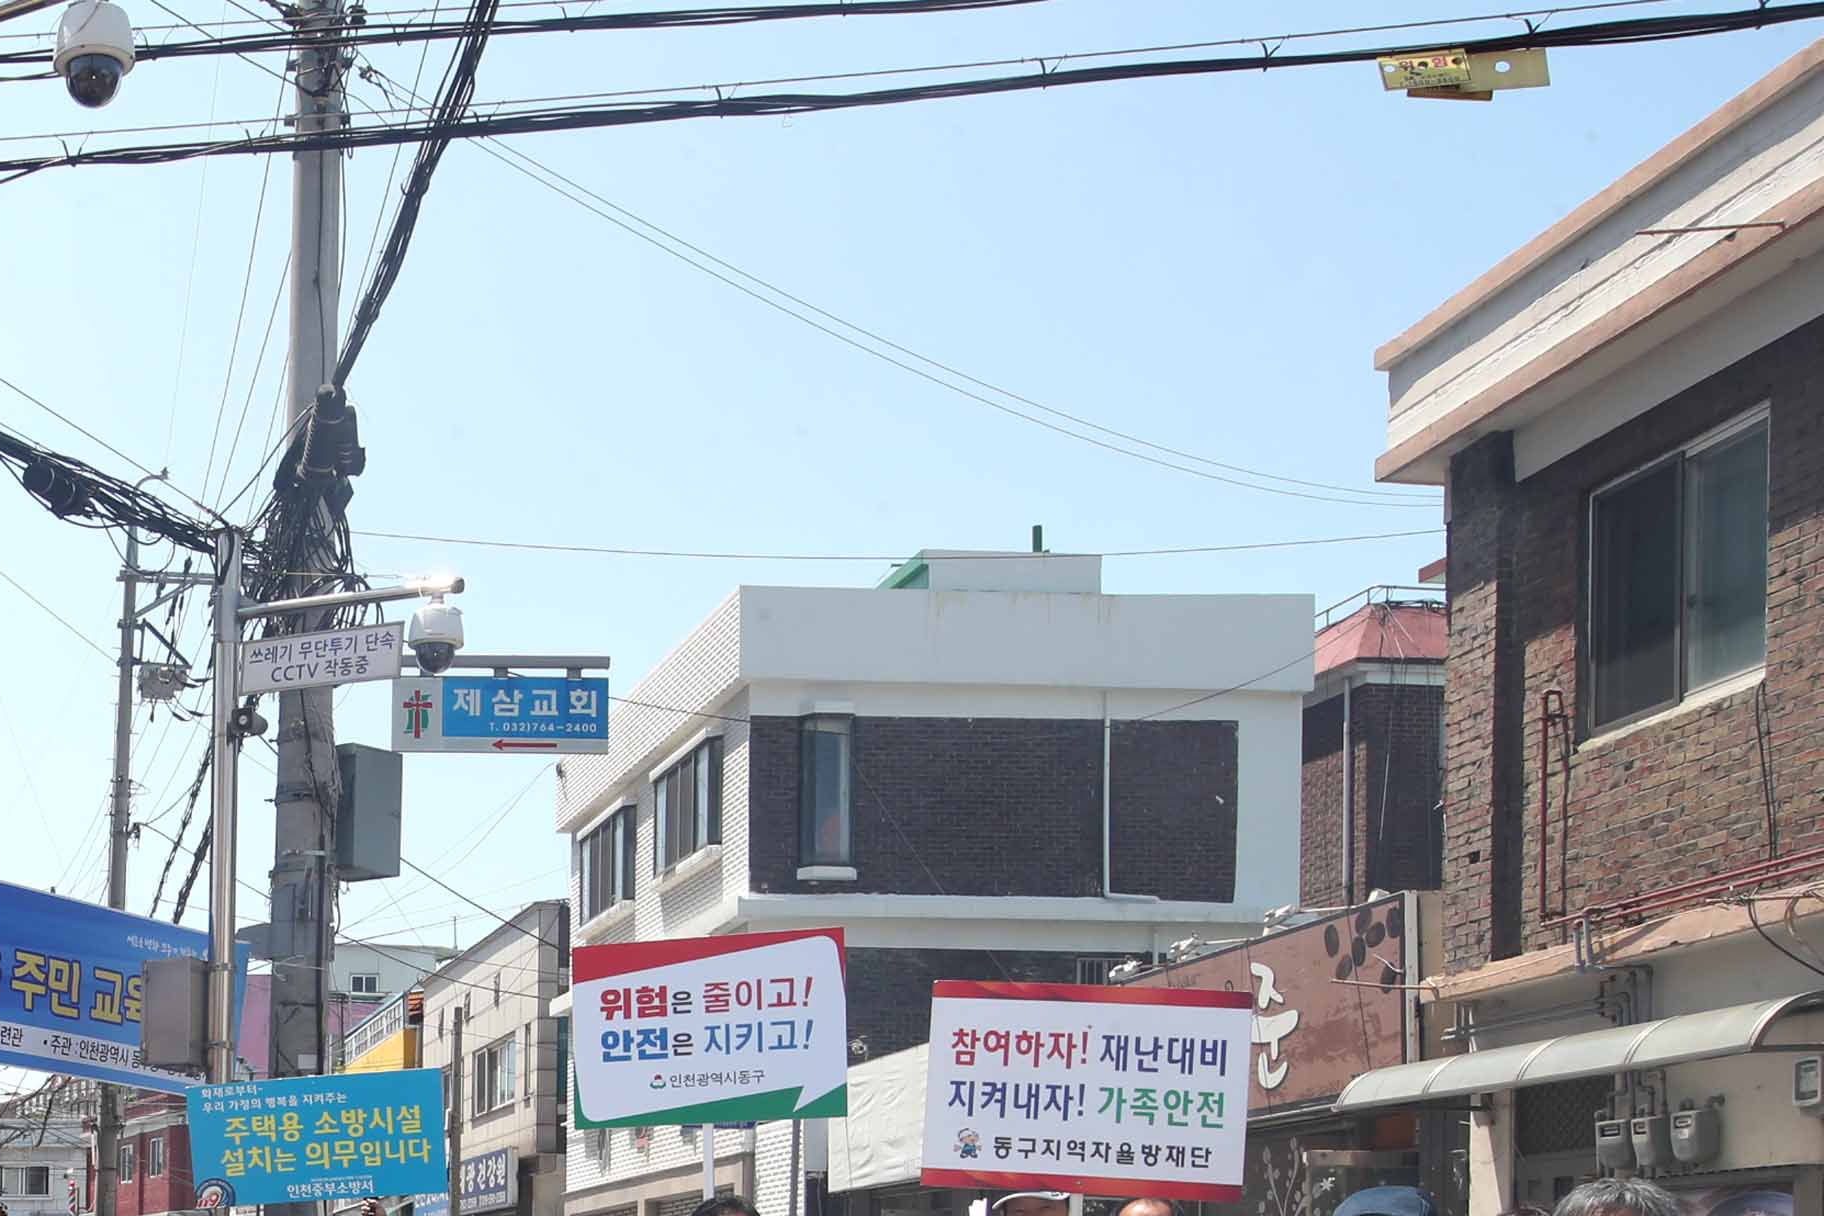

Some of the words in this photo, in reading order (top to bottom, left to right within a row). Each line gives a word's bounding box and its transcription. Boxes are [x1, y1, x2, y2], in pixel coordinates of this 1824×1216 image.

[249, 643, 293, 665] 쓰레기
[299, 639, 358, 660] 무단투기
[365, 632, 396, 652] 단속
[271, 663, 320, 683] CCTV
[325, 656, 370, 678] 작동중
[11, 949, 82, 1019] 주민
[599, 984, 694, 1021] 위험은
[702, 975, 813, 1014] 줄이고!
[50, 1035, 73, 1058] 주관
[79, 1039, 130, 1066] 인천광역시
[601, 1026, 694, 1063] 안전은
[704, 1019, 814, 1055] 지키고!
[951, 1027, 1089, 1069] 참여하자!
[1099, 1034, 1228, 1076] 재난대비
[669, 1069, 766, 1089] 인천광역시동구
[202, 1101, 225, 1113] 우리
[228, 1098, 262, 1111] 가정의
[302, 1092, 348, 1105] 지켜주는
[948, 1080, 1086, 1121] 지켜내자!
[1097, 1086, 1226, 1129] 가족안전
[223, 1111, 304, 1145] 주택용
[313, 1104, 424, 1138] 소방시설
[221, 1146, 297, 1177] 설치는
[305, 1138, 432, 1170] 의무입니다
[993, 1136, 1213, 1169] 동구지역자율방재단
[287, 1180, 374, 1198] 인천중부소방서
